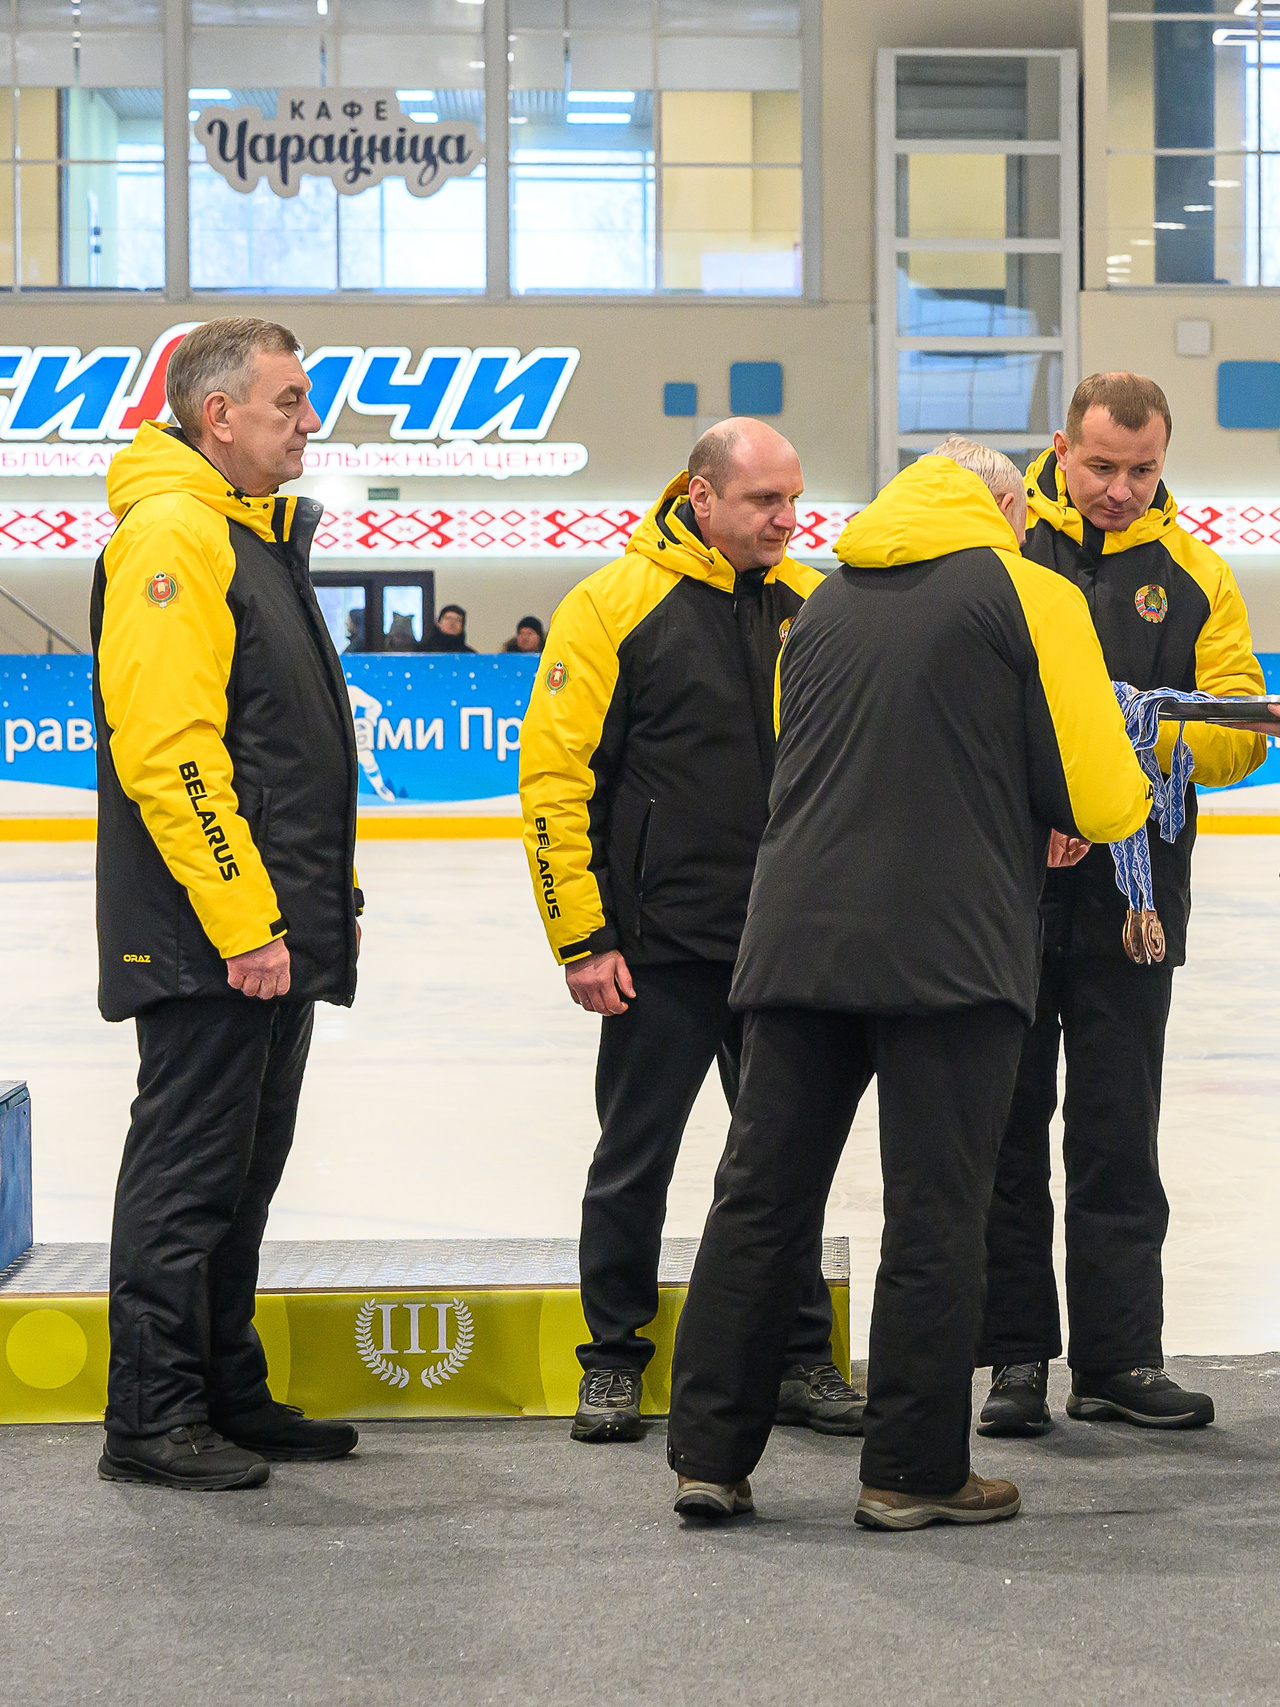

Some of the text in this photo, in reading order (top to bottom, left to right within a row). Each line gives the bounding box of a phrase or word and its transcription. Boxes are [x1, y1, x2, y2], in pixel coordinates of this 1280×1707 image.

[289, 100, 389, 121] КАФЕ
[207, 118, 473, 187] Чараўніца
[1, 452, 113, 468] БЛИКА
[483, 452, 580, 469] ЦЕНТР
[4, 717, 98, 764] рав
[178, 760, 241, 882] BELARUS
[534, 816, 562, 920] BELARUS
[123, 954, 152, 963] ORAZ
[375, 1303, 455, 1354] III
